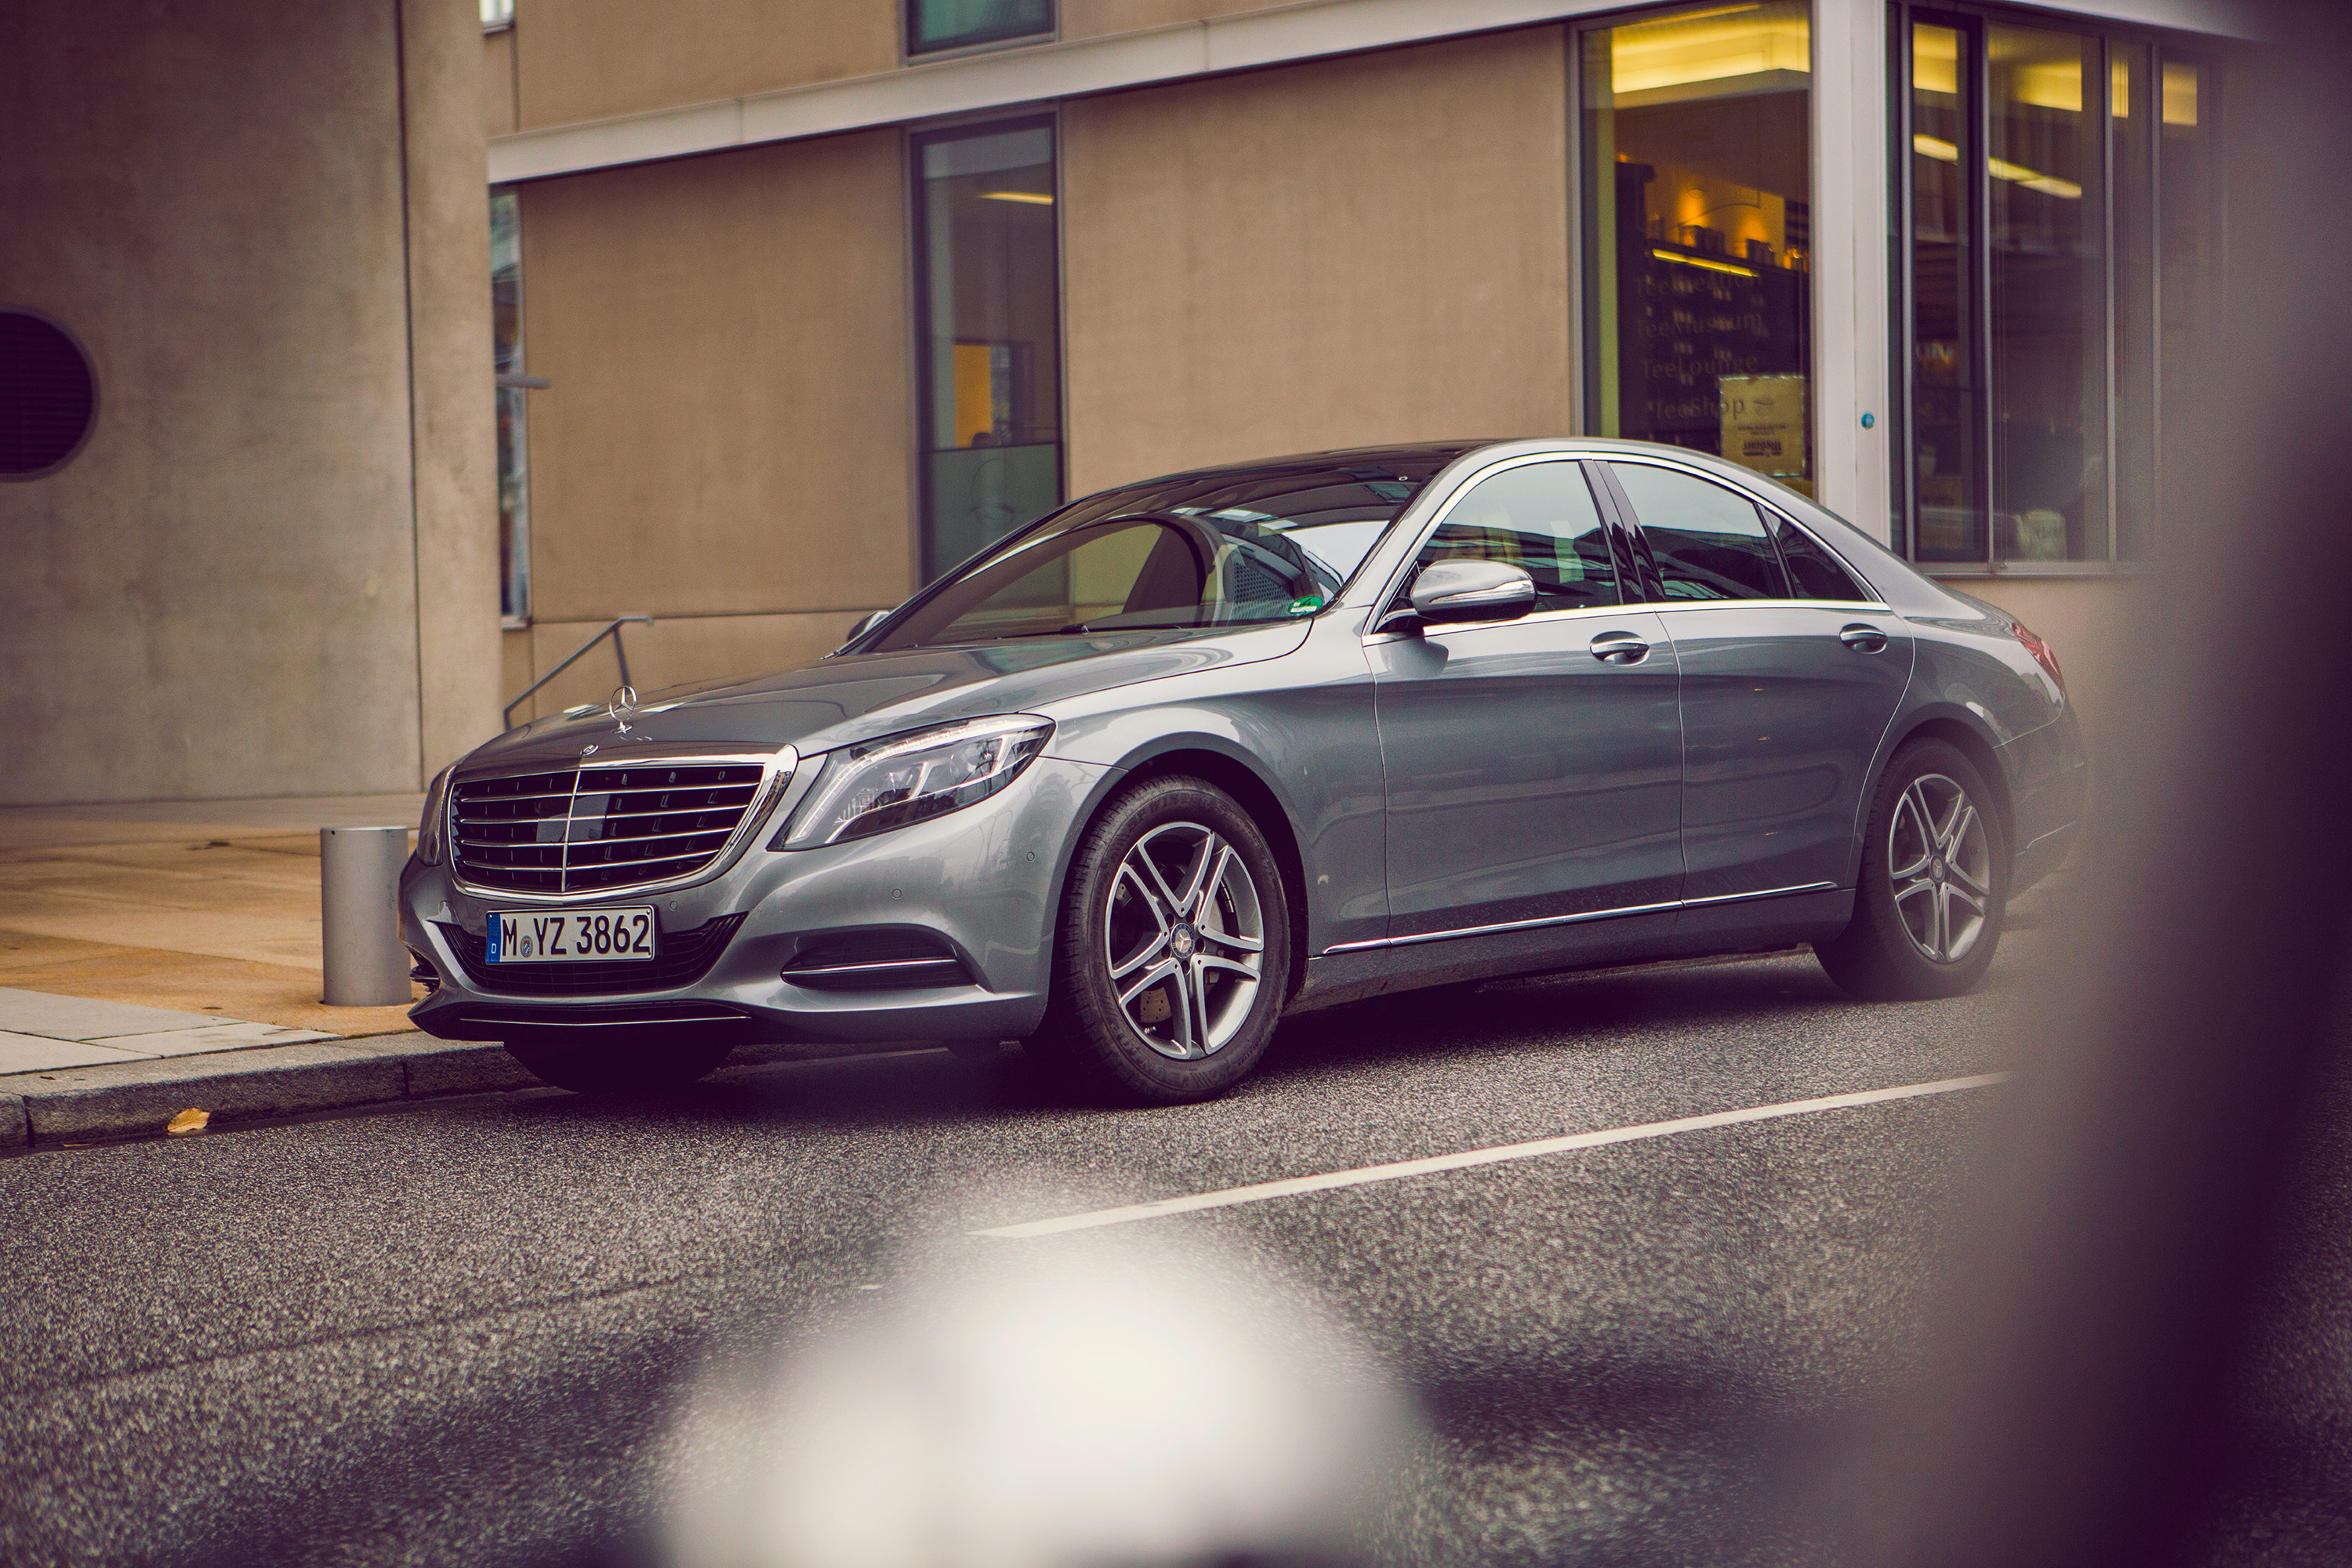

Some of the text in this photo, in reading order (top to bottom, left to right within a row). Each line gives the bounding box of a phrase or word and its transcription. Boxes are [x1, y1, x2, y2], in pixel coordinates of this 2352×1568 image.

[491, 914, 651, 956] D M YZ 3862
